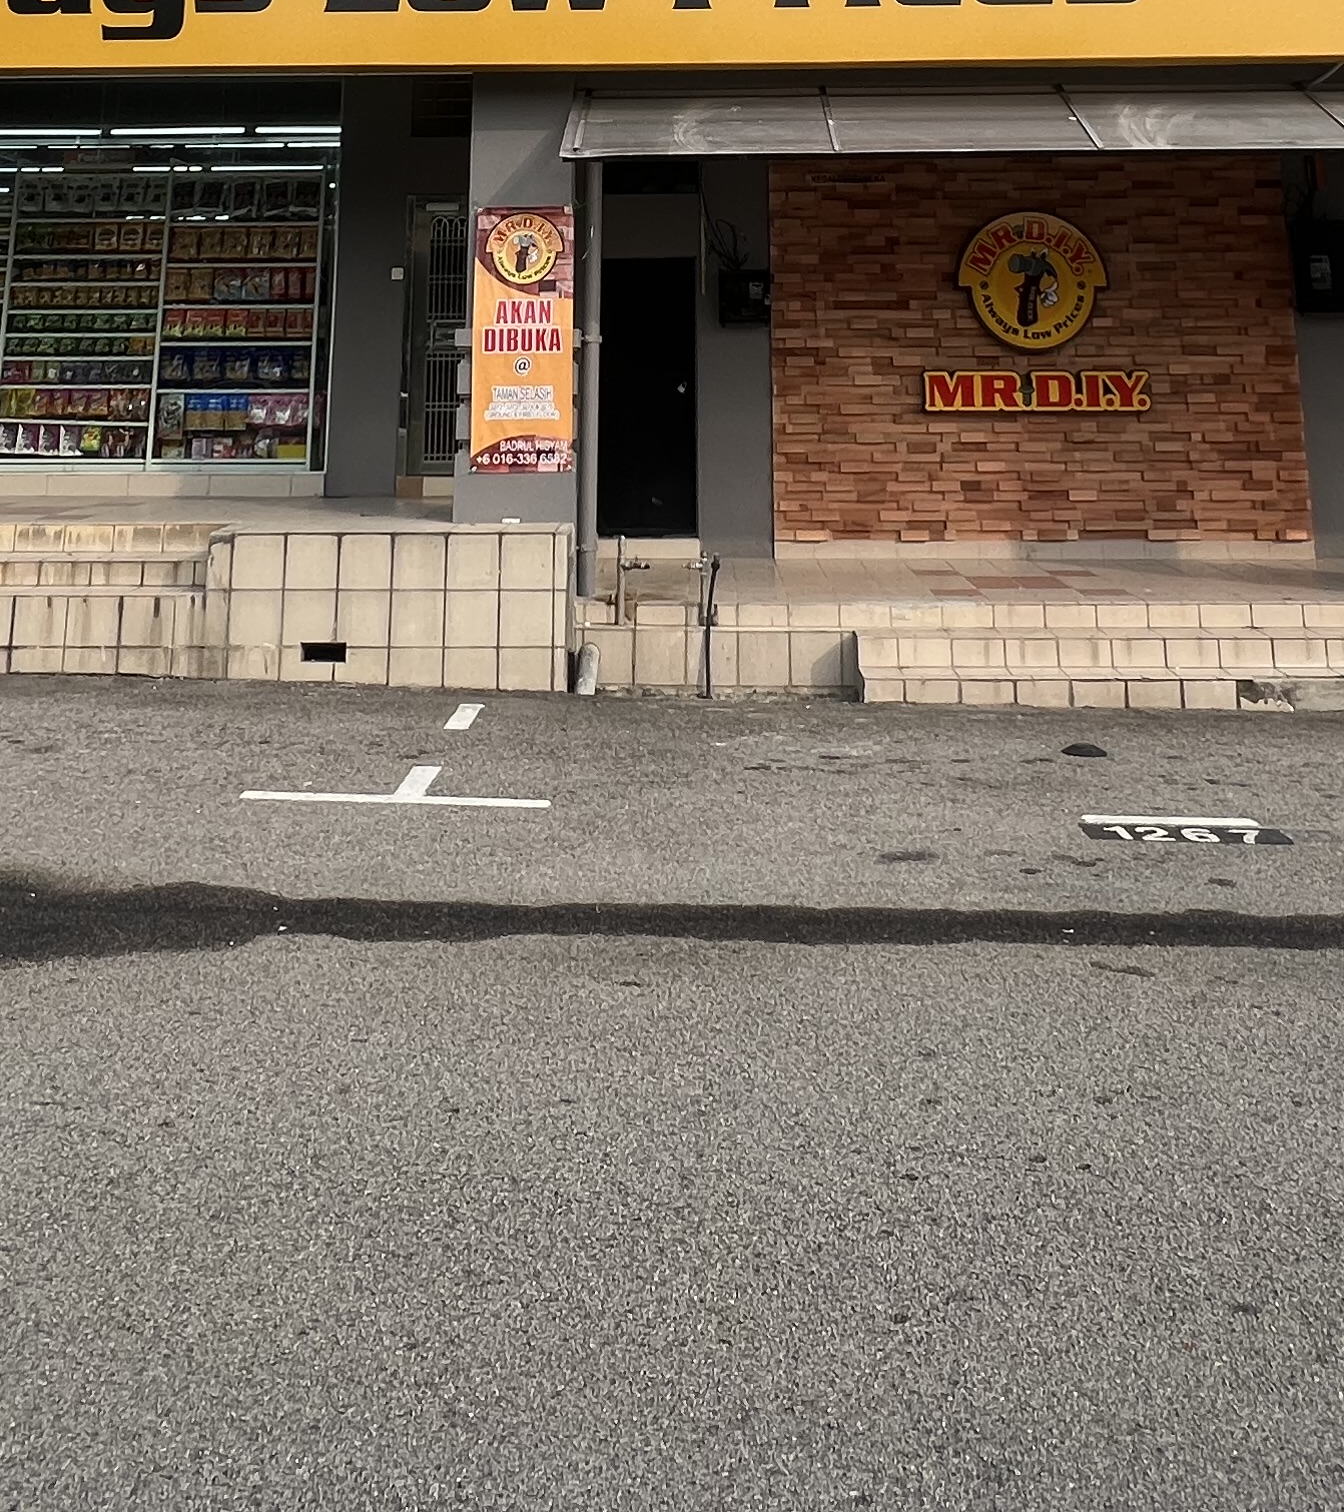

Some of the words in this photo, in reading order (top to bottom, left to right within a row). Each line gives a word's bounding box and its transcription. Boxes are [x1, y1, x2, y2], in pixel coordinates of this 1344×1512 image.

[495, 299, 552, 324] AKAN
[981, 293, 1019, 337] Always
[1023, 328, 1052, 340] Low
[1053, 294, 1086, 335] Prices
[483, 327, 562, 352] DIBUKA
[493, 387, 519, 400] TAMAN
[499, 440, 534, 452] BADRUL
[476, 453, 491, 465] +6
[492, 453, 538, 465] 016-336
[1102, 825, 1261, 845] 1267
